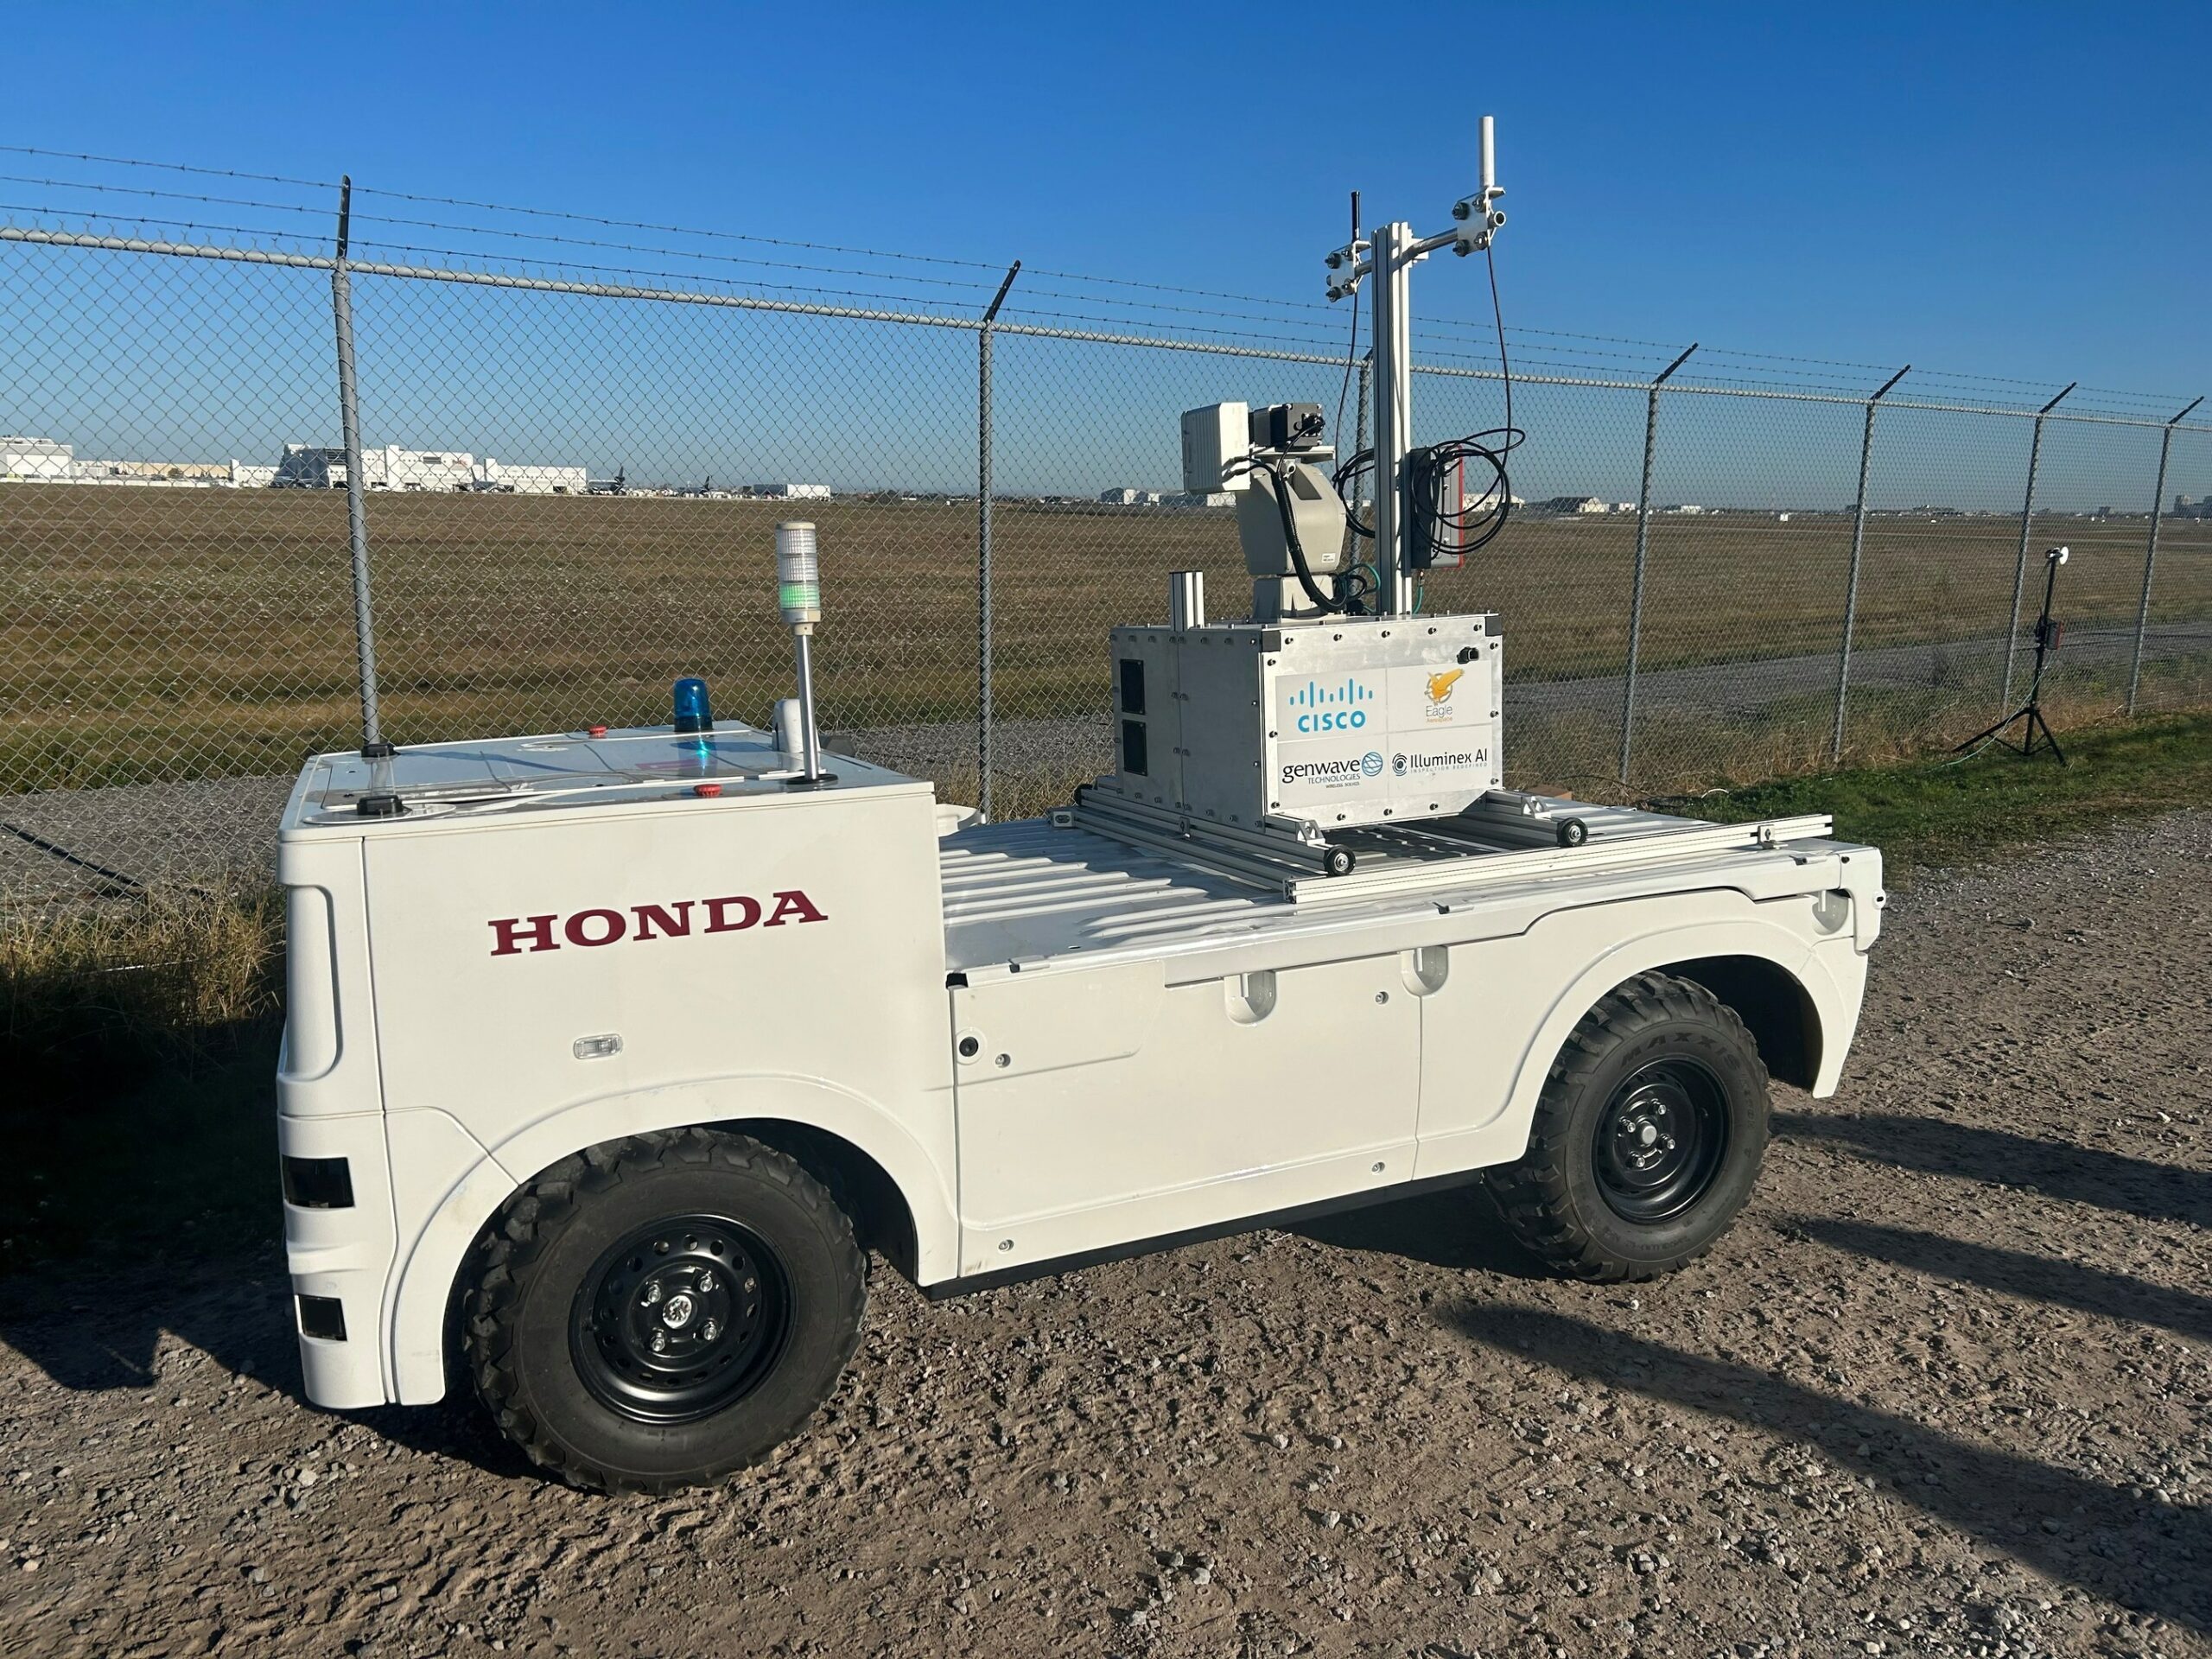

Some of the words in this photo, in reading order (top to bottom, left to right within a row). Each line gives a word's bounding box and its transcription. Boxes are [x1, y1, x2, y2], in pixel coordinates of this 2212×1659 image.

[1298, 710, 1366, 733] CISCO
[1426, 705, 1453, 718] Eagle
[1410, 752, 1471, 768] Illuminex
[1475, 748, 1487, 762] AI
[1281, 760, 1360, 784] genwave
[1308, 773, 1361, 785] TECHNOLOGIES
[487, 890, 829, 957] HONDA
[1620, 1032, 1741, 1070] MAXXIS
